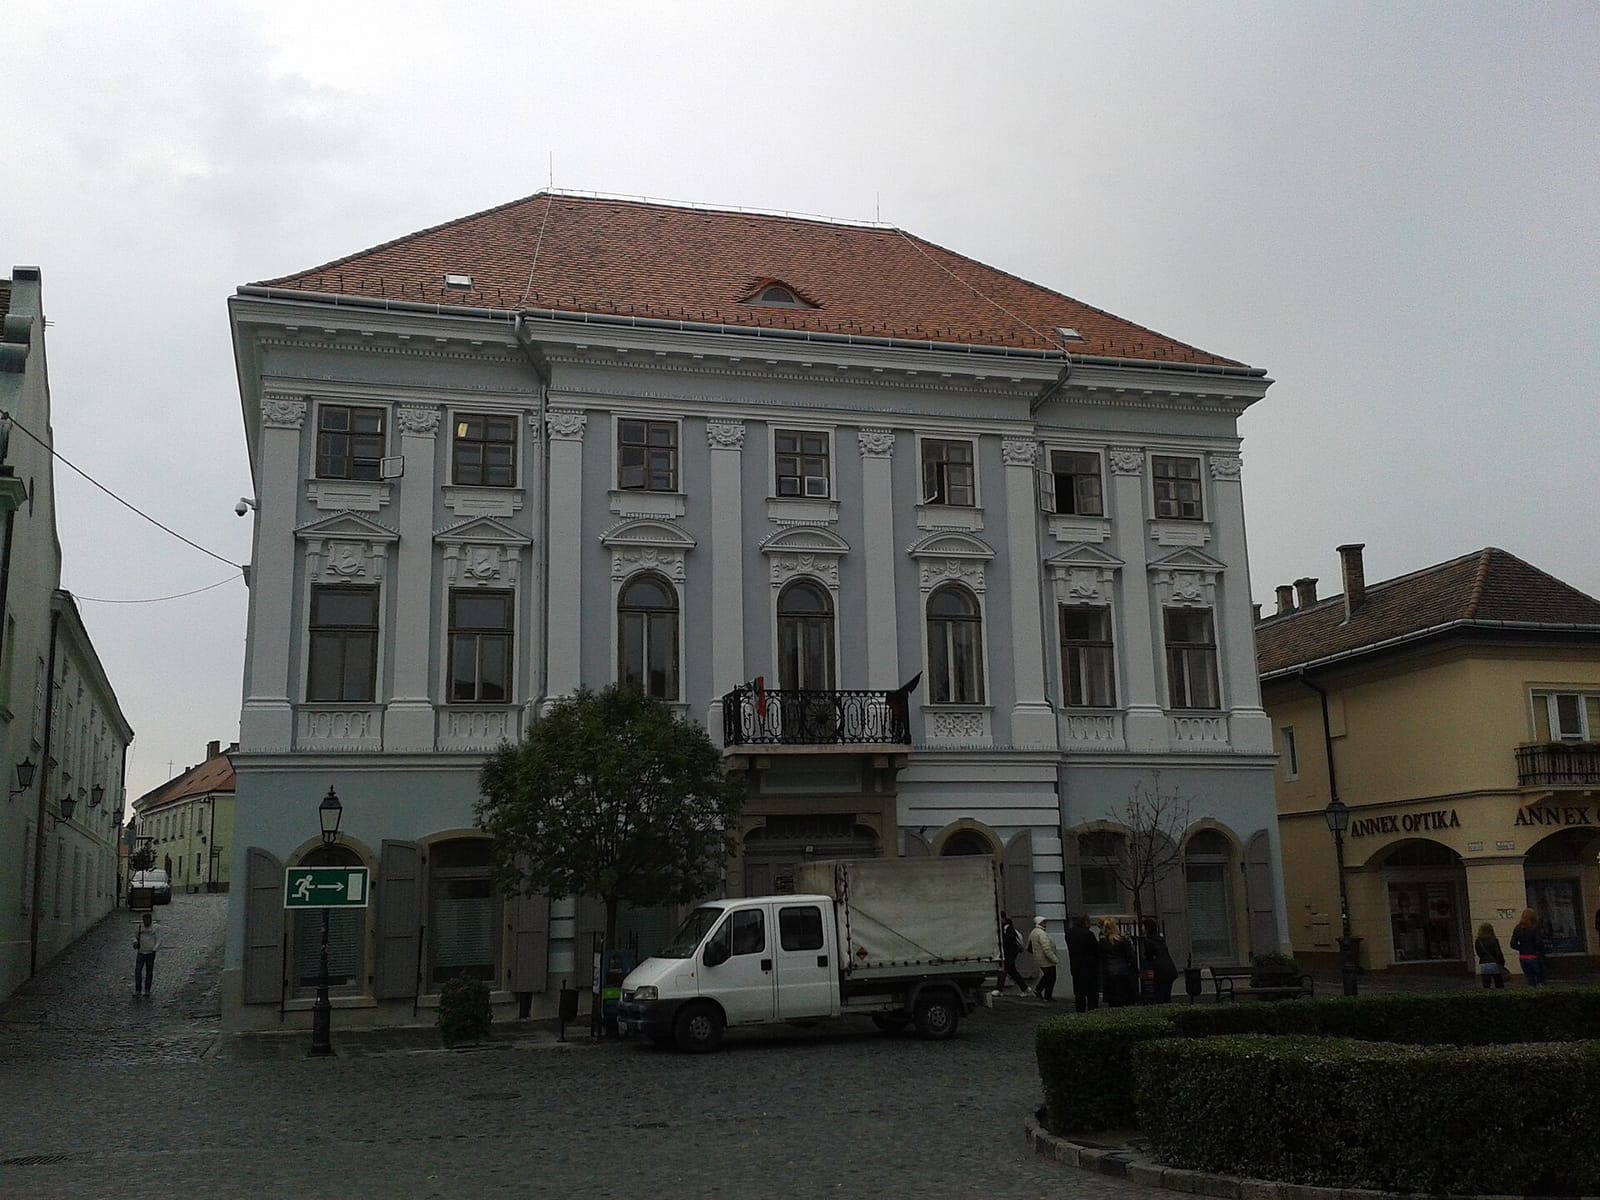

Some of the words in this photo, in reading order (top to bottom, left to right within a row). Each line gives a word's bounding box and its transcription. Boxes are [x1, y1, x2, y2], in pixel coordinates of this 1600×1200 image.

[1351, 815, 1400, 838] ANNEX
[1402, 809, 1461, 832] OPTIKA
[1514, 806, 1592, 825] ANNEX
